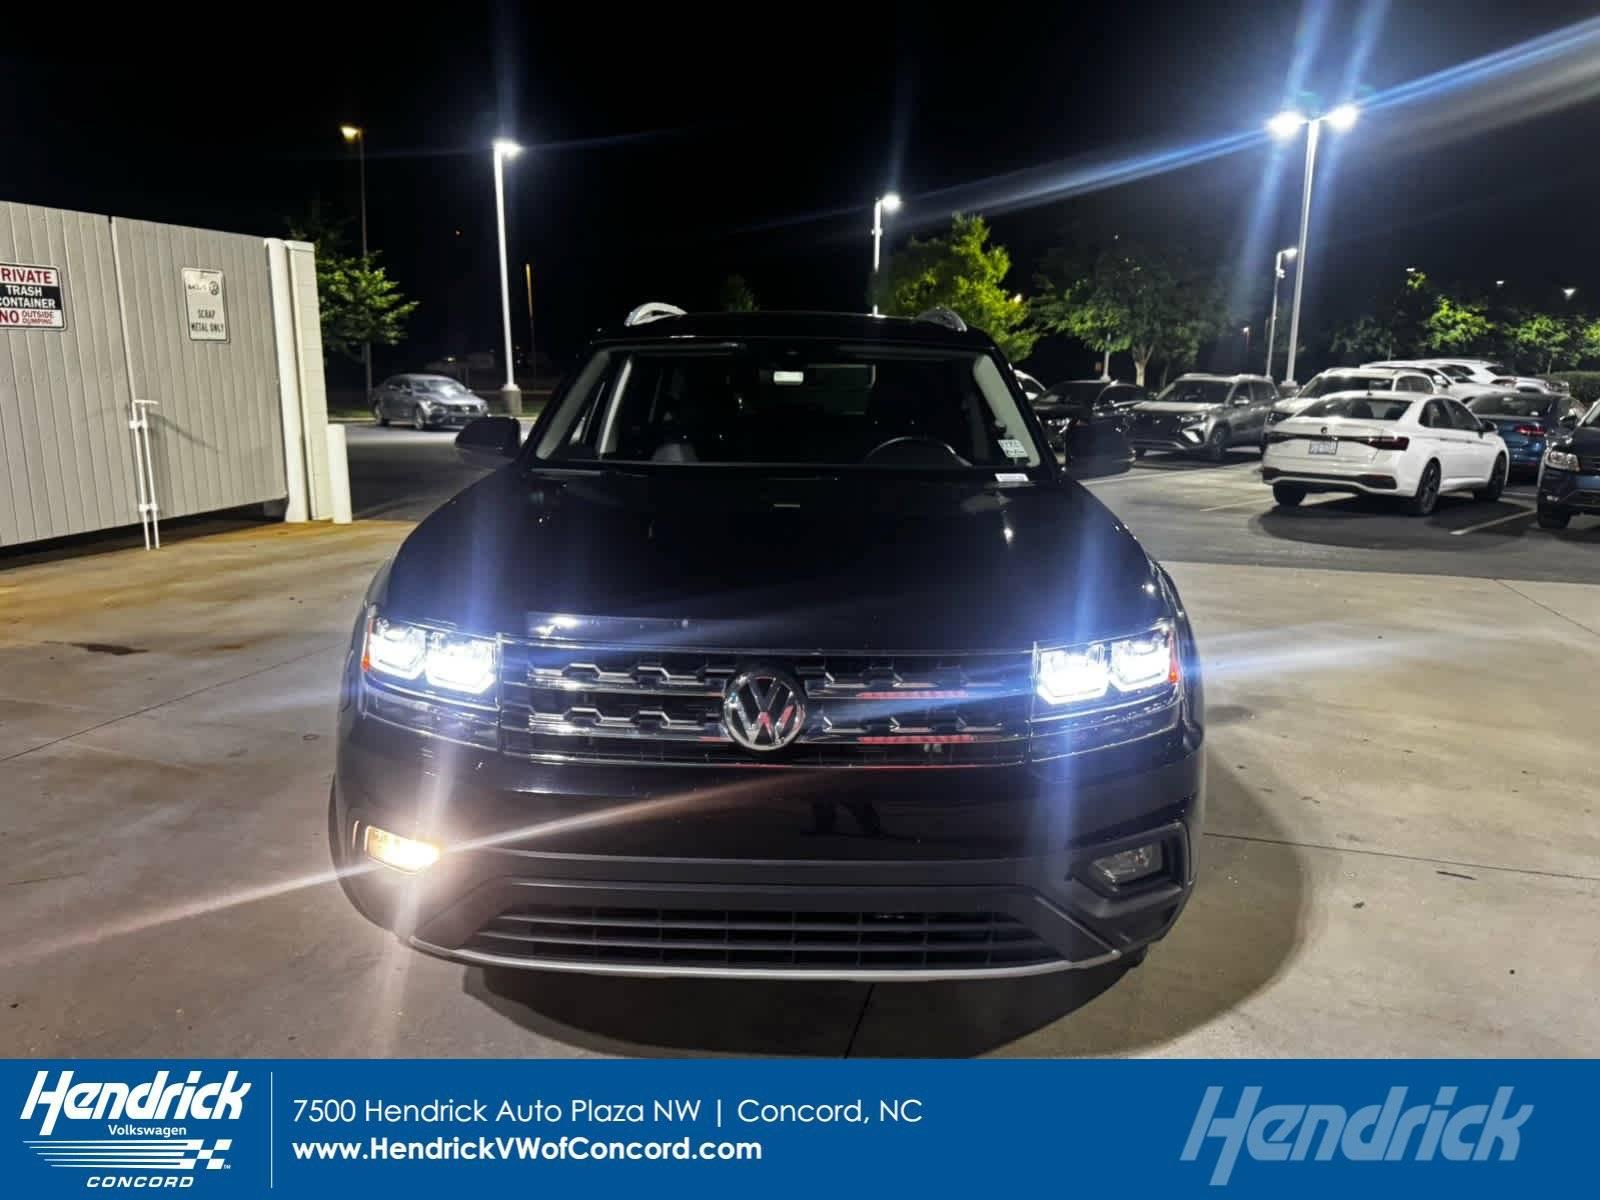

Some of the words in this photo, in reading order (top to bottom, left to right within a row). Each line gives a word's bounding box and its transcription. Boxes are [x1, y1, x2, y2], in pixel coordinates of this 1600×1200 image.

[0, 267, 53, 285] RIVATE
[5, 284, 43, 297] TRASH
[0, 295, 56, 309] ONTAINER
[0, 309, 20, 324] NO
